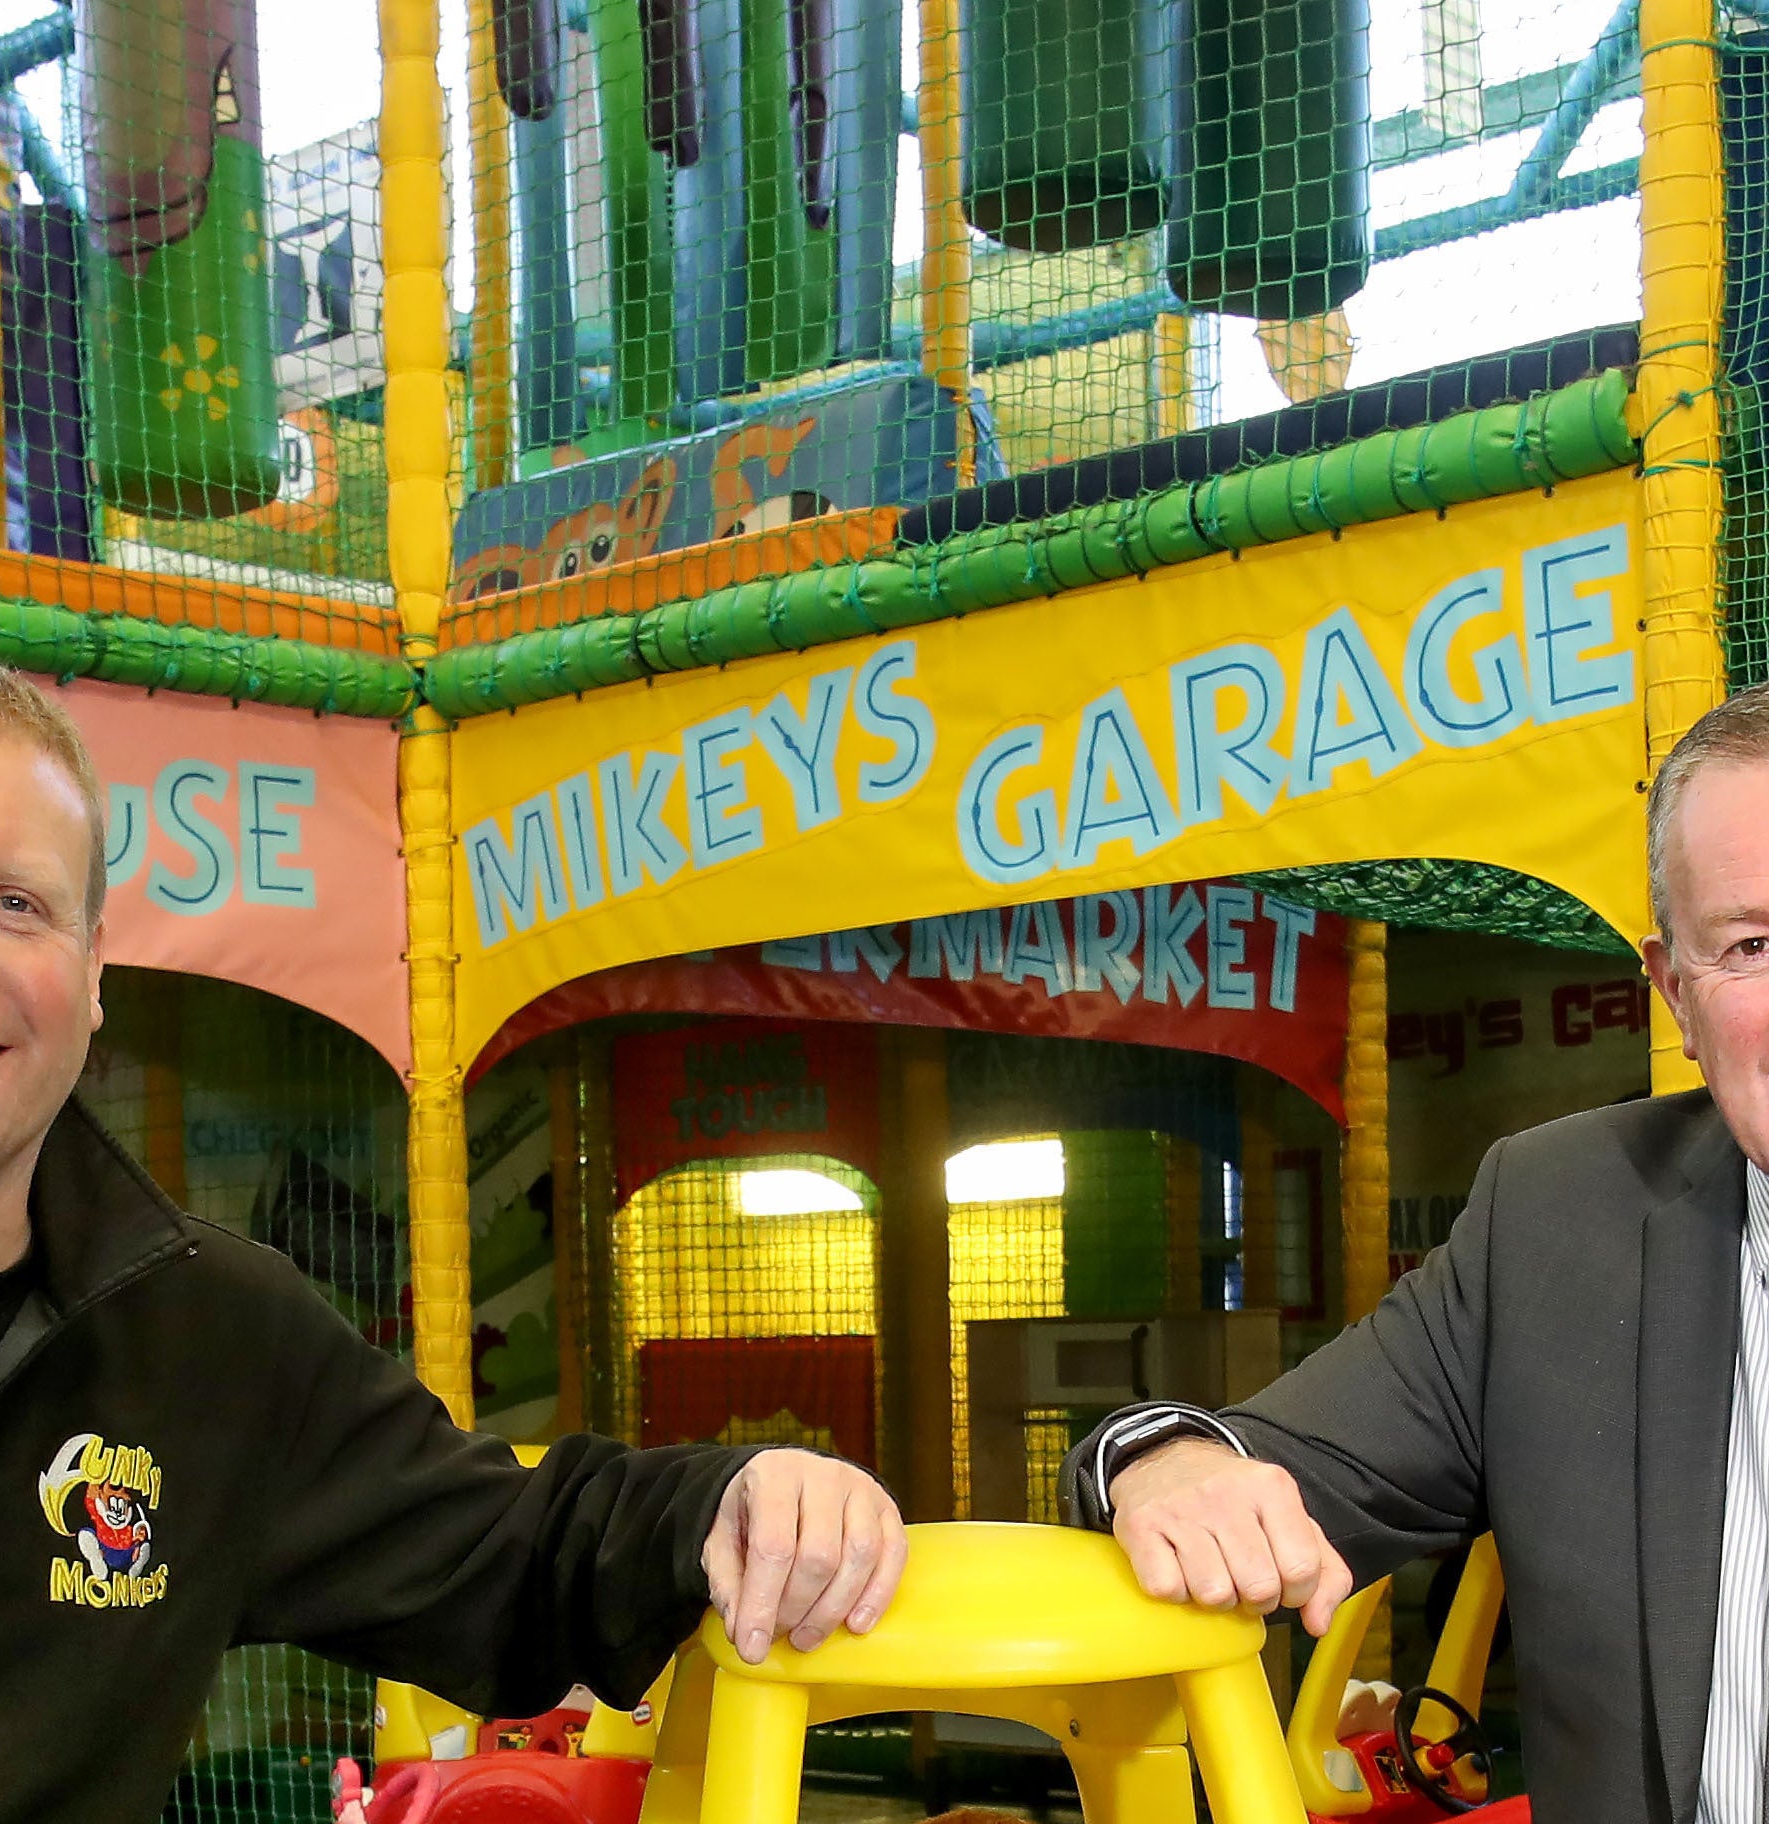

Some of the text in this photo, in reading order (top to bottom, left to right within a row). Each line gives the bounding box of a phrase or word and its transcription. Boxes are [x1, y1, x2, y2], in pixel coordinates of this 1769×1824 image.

[463, 522, 1636, 949] MIKEYS GARAGE
[1387, 996, 1524, 1080] ey's
[671, 1085, 828, 1143] TOUGH
[49, 1556, 169, 1609] MONKEYS
